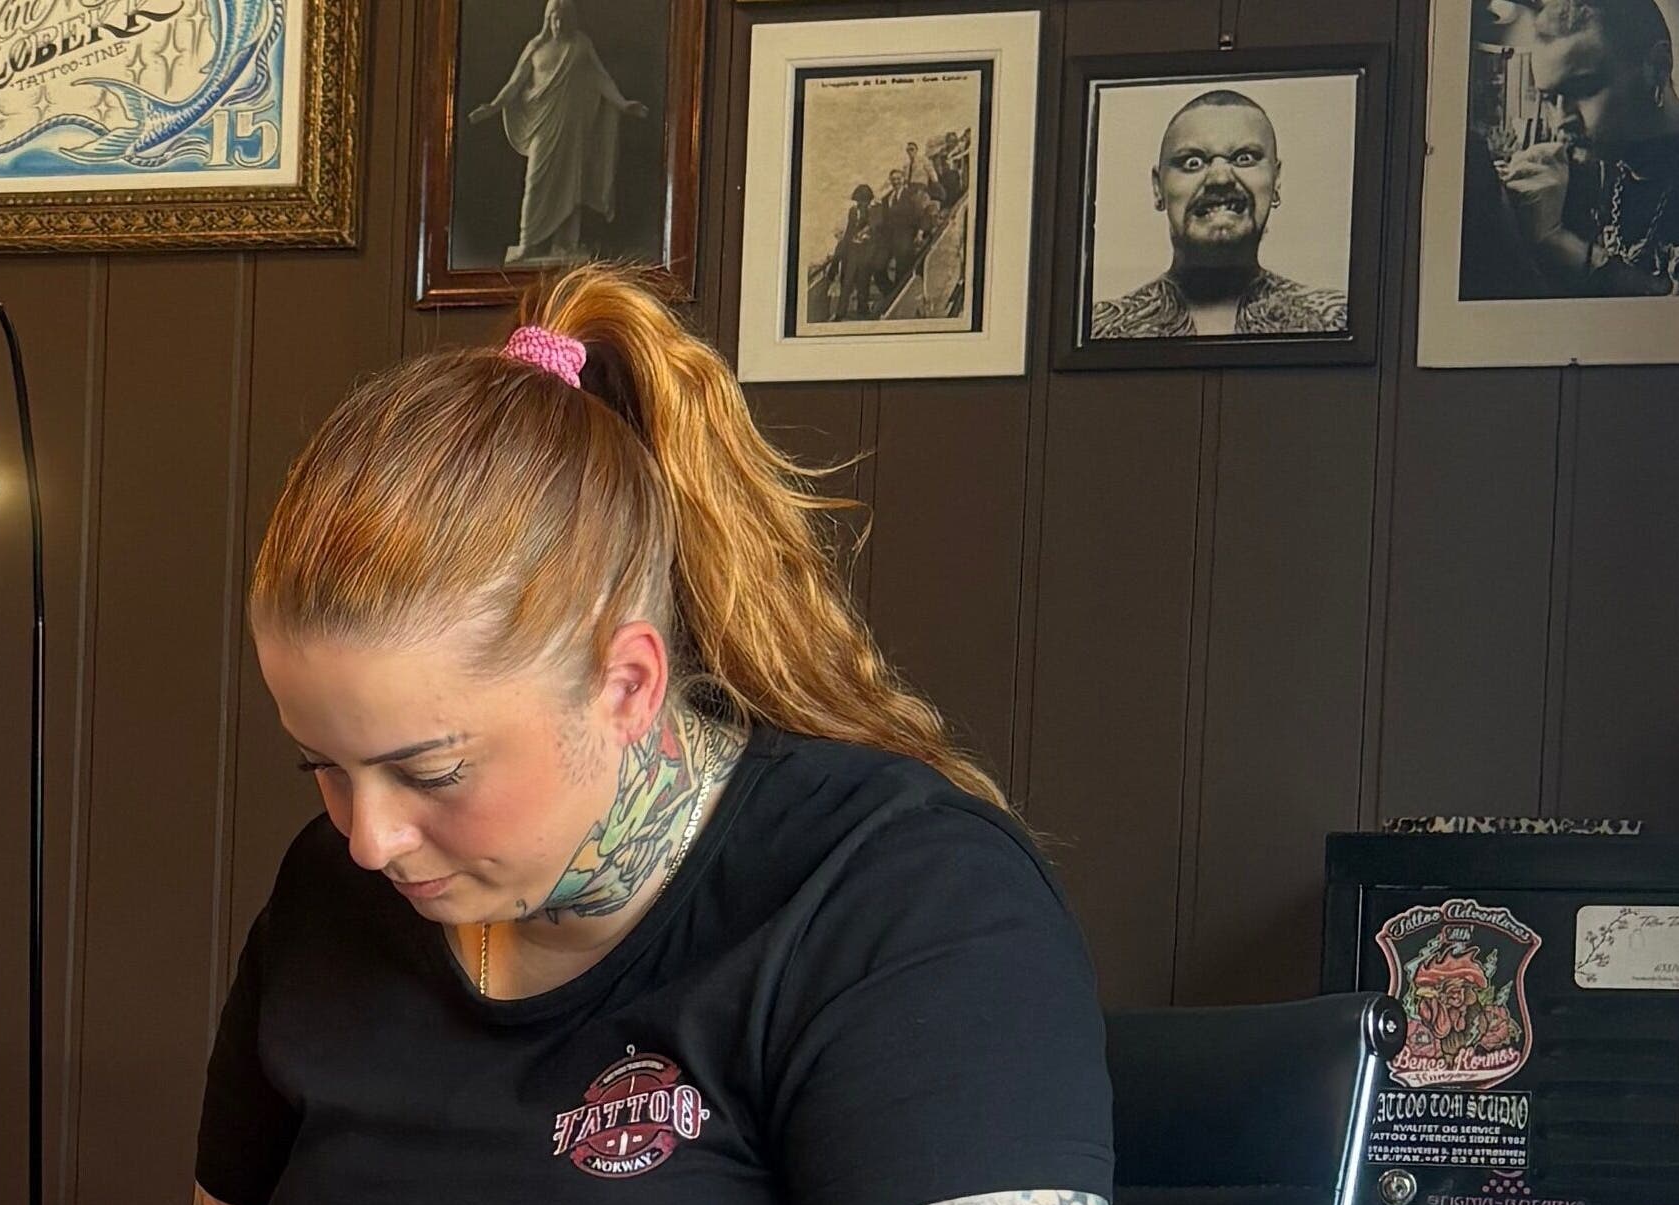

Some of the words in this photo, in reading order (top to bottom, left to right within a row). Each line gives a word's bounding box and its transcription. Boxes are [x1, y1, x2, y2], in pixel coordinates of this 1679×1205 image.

[202, 103, 280, 168] 15
[553, 1085, 711, 1155] TATTOO
[1372, 1093, 1428, 1124] ATTOO
[1419, 1133, 1467, 1143] PIERCING
[591, 1152, 654, 1174] NORWAY
